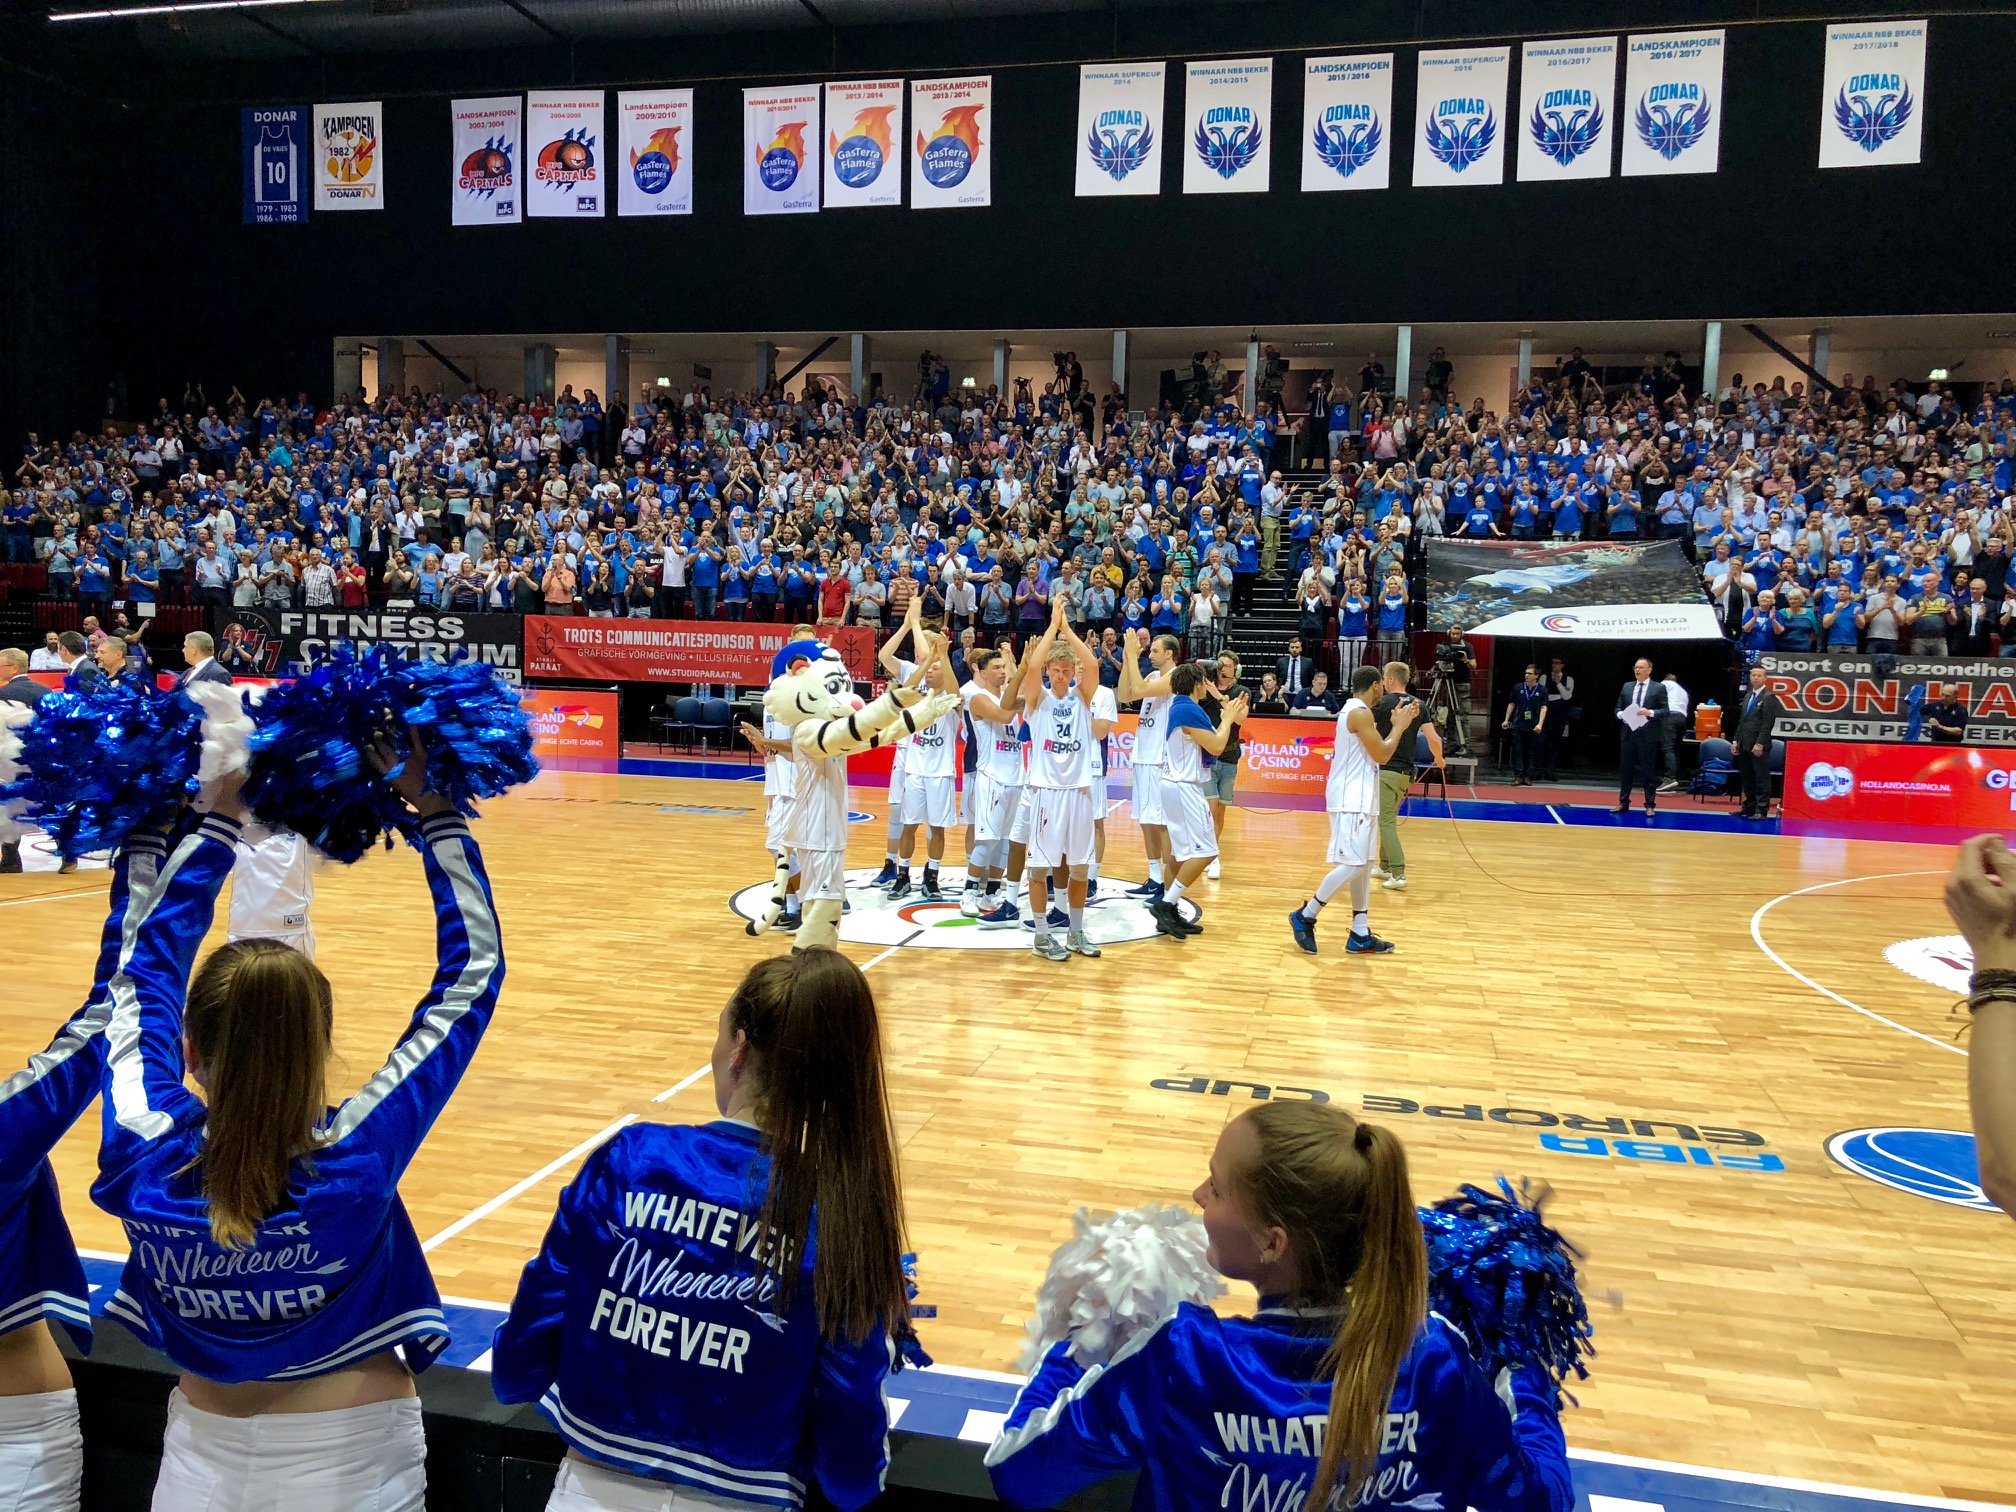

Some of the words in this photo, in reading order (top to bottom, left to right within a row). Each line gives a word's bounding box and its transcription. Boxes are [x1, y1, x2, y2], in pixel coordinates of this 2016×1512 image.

[1830, 31, 1873, 40] WINNAAR
[1874, 30, 1892, 38] NBB
[1894, 29, 1923, 37] BEKER
[1631, 37, 1721, 52] LANDSKAMPIOEN
[1852, 41, 1899, 50] 2017/2018
[1526, 48, 1566, 57] WINNAAR
[1567, 47, 1584, 55] NBB
[1586, 45, 1613, 54] BEKER
[1422, 58, 1460, 66] WINNAAR
[1462, 56, 1506, 64] SUPERCUP
[1547, 57, 1591, 67] 2016/2017
[1190, 67, 1226, 76] WINNAAR
[1244, 65, 1269, 73] BEKER
[1308, 61, 1390, 74] LANDSKAMPIOEN
[829, 83, 862, 91] WINNAAR
[878, 81, 900, 89] BEKER
[915, 80, 988, 92] LANDSKAMPIOEN
[1209, 76, 1249, 84] 2014/2015
[1848, 73, 1901, 94] DONAR
[1649, 83, 1699, 103] DONAR
[748, 98, 778, 106] WINNAAR
[795, 96, 816, 104] BEKER
[1544, 89, 1592, 110] DONAR
[624, 101, 688, 111] Landskampioen
[767, 105, 797, 113] 2010/2011
[1438, 97, 1485, 117] DONAR
[254, 111, 297, 122] DONAR
[456, 109, 517, 119] LANDSKAMPIOEN
[635, 111, 677, 120] 2009/2010
[1099, 109, 1143, 128] DONAR
[1206, 106, 1251, 125] DONAR
[1325, 104, 1371, 123] DONAR
[323, 116, 375, 140] KAMPIOEN
[329, 147, 350, 156] 1982
[837, 147, 880, 159] GasTerra
[925, 147, 968, 159] GasTerra
[636, 161, 670, 171] GasTerra
[762, 157, 796, 168] GasTerra
[840, 158, 877, 170] Flames
[928, 158, 965, 170] Flames
[267, 162, 286, 184] 10
[535, 168, 597, 181] CAPITALS
[639, 170, 667, 178] Flames
[765, 167, 793, 176] Flames
[458, 174, 513, 190] CAPITALS
[329, 191, 362, 199] DONAR
[257, 205, 273, 213] 1979
[280, 204, 298, 213] 1983
[656, 203, 686, 211] GasTerra
[783, 200, 812, 209] GasTerra
[257, 214, 273, 222] 1986
[280, 214, 298, 222] 1990
[281, 612, 465, 639] FITNESS
[1586, 617, 1688, 626] MartiniPlaza
[563, 628, 603, 644] TROTS
[606, 630, 754, 650] COMMUNICATIESPONSOR
[759, 635, 782, 651] VAN
[577, 648, 627, 659] GRAFISCHE
[629, 650, 686, 661] VORMGEVING
[696, 653, 752, 664] ILLUSTRATIE
[530, 662, 561, 671] PARAAT
[1761, 656, 1832, 674] Sport
[1839, 660, 1872, 674] en
[648, 667, 743, 679] WWW.STUDIOPARAAT.NL
[1766, 675, 1901, 715] RON
[1052, 707, 1073, 717] DONAR
[1145, 702, 1152, 715] 3
[1138, 717, 1155, 728] PRO
[1055, 723, 1072, 739] 24
[1779, 720, 1869, 737] DAGEN
[1965, 727, 2016, 741] EEK
[559, 738, 578, 746] ECHTE
[579, 738, 603, 747] CASINO
[912, 733, 945, 748] HEPRO
[1043, 738, 1082, 755] HEPRO
[1240, 740, 1310, 757] HOLLAND
[1247, 754, 1301, 770] CASINO
[1261, 772, 1275, 780] HET
[1276, 772, 1298, 781] ENIGE
[1300, 774, 1324, 782] ECHTE
[1837, 777, 1850, 786] 18+
[1860, 781, 1951, 792] HOLLANDCASINO.NL
[1149, 1077, 1331, 1104] CUP
[1362, 1094, 1766, 1147] EUROPE
[1537, 1132, 1786, 1172] FIBA
[139, 1240, 319, 1284] Whenever
[608, 1237, 776, 1303] Whenever
[589, 1288, 751, 1375] FOREVER
[1213, 1410, 1419, 1458] WHATER
[1221, 1460, 1419, 1512] Whnever
